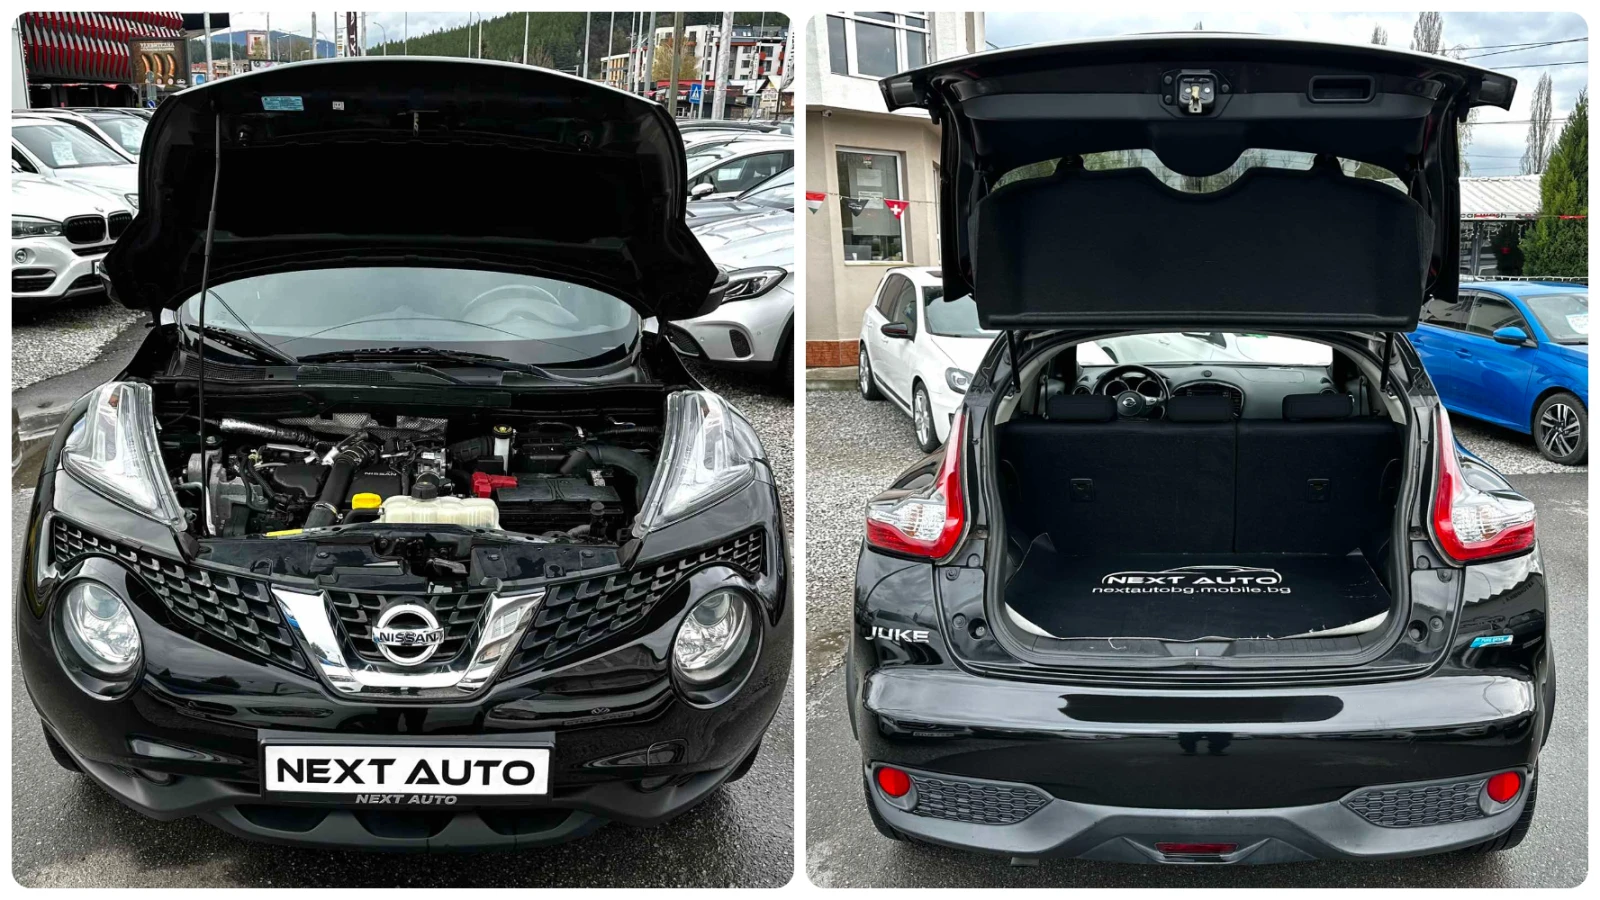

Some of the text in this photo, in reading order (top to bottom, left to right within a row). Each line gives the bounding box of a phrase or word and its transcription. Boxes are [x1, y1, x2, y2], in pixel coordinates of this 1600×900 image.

[1107, 576, 1278, 585] NEXT AUTO
[1092, 586, 1291, 595] nextautobg.mobile.bg
[379, 631, 437, 643] NISSAN
[864, 626, 930, 644] JUKE
[277, 757, 536, 786] NEXT AUTO
[355, 794, 458, 805] NEXT AUTO
